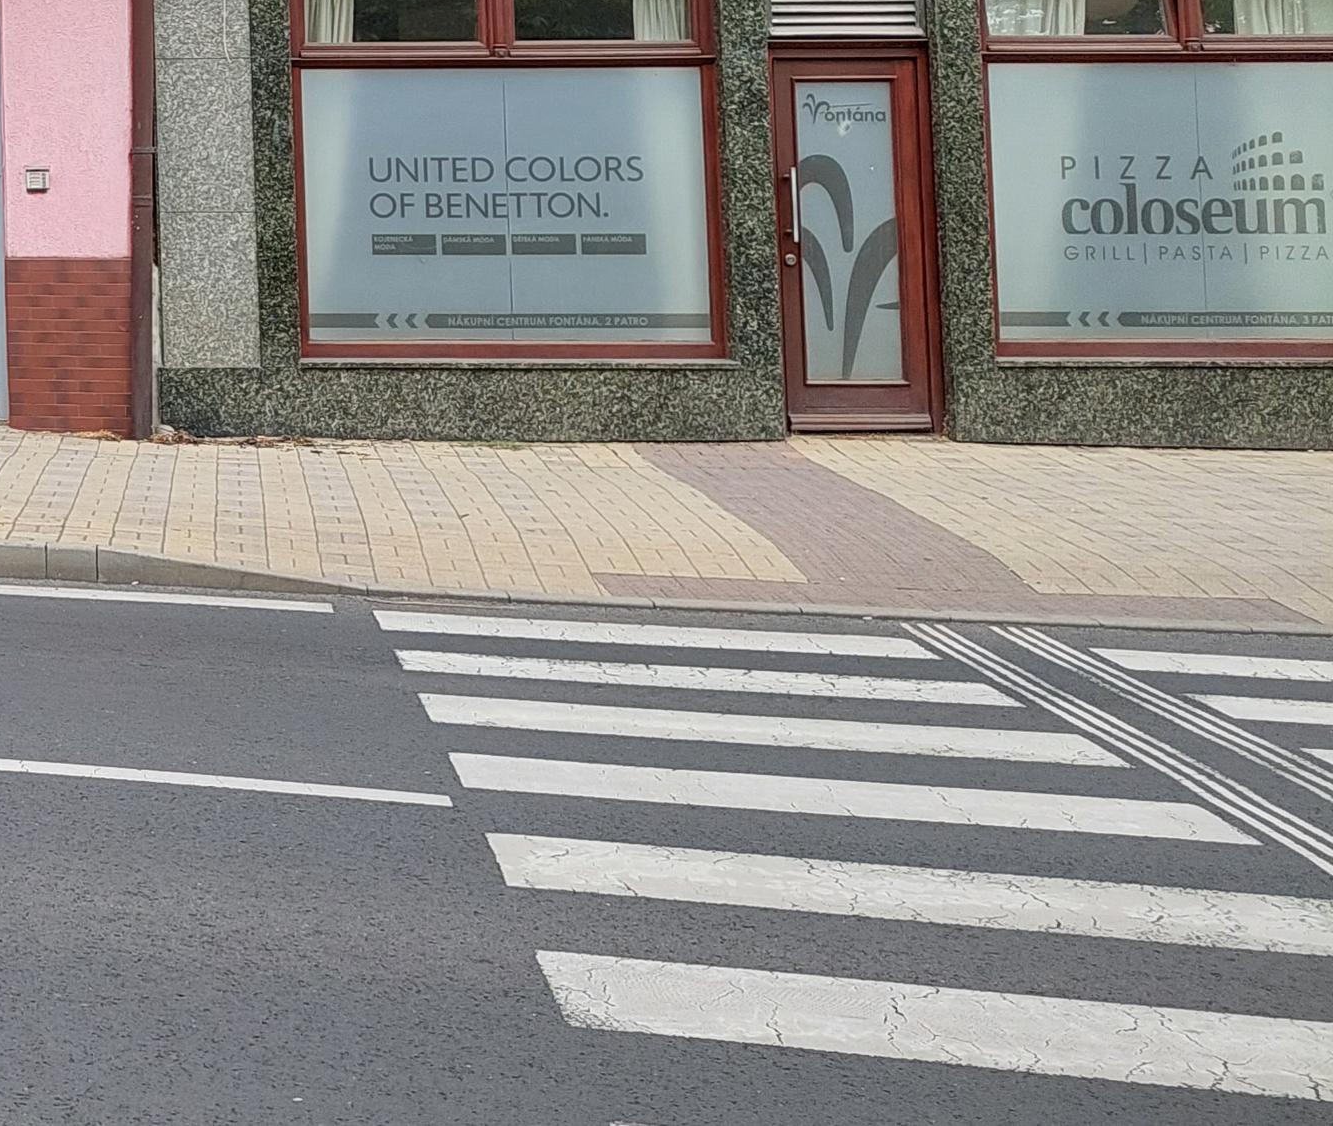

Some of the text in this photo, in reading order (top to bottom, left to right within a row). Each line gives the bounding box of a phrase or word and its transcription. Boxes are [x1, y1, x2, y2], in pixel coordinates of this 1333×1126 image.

[368, 155, 644, 183] UNITED COLORS
[1060, 156, 1213, 180] PIZZA
[369, 191, 609, 219] OF BENETTON.
[1061, 182, 1327, 235] coloseum
[1063, 245, 1329, 261] GRILL PASTA PIZZA
[448, 314, 494, 326] NÁKUPNÍ
[496, 316, 546, 327] CENTRUM
[604, 317, 613, 326] 2
[615, 316, 649, 326] PATRO
[1191, 314, 1241, 325] CENTRUM
